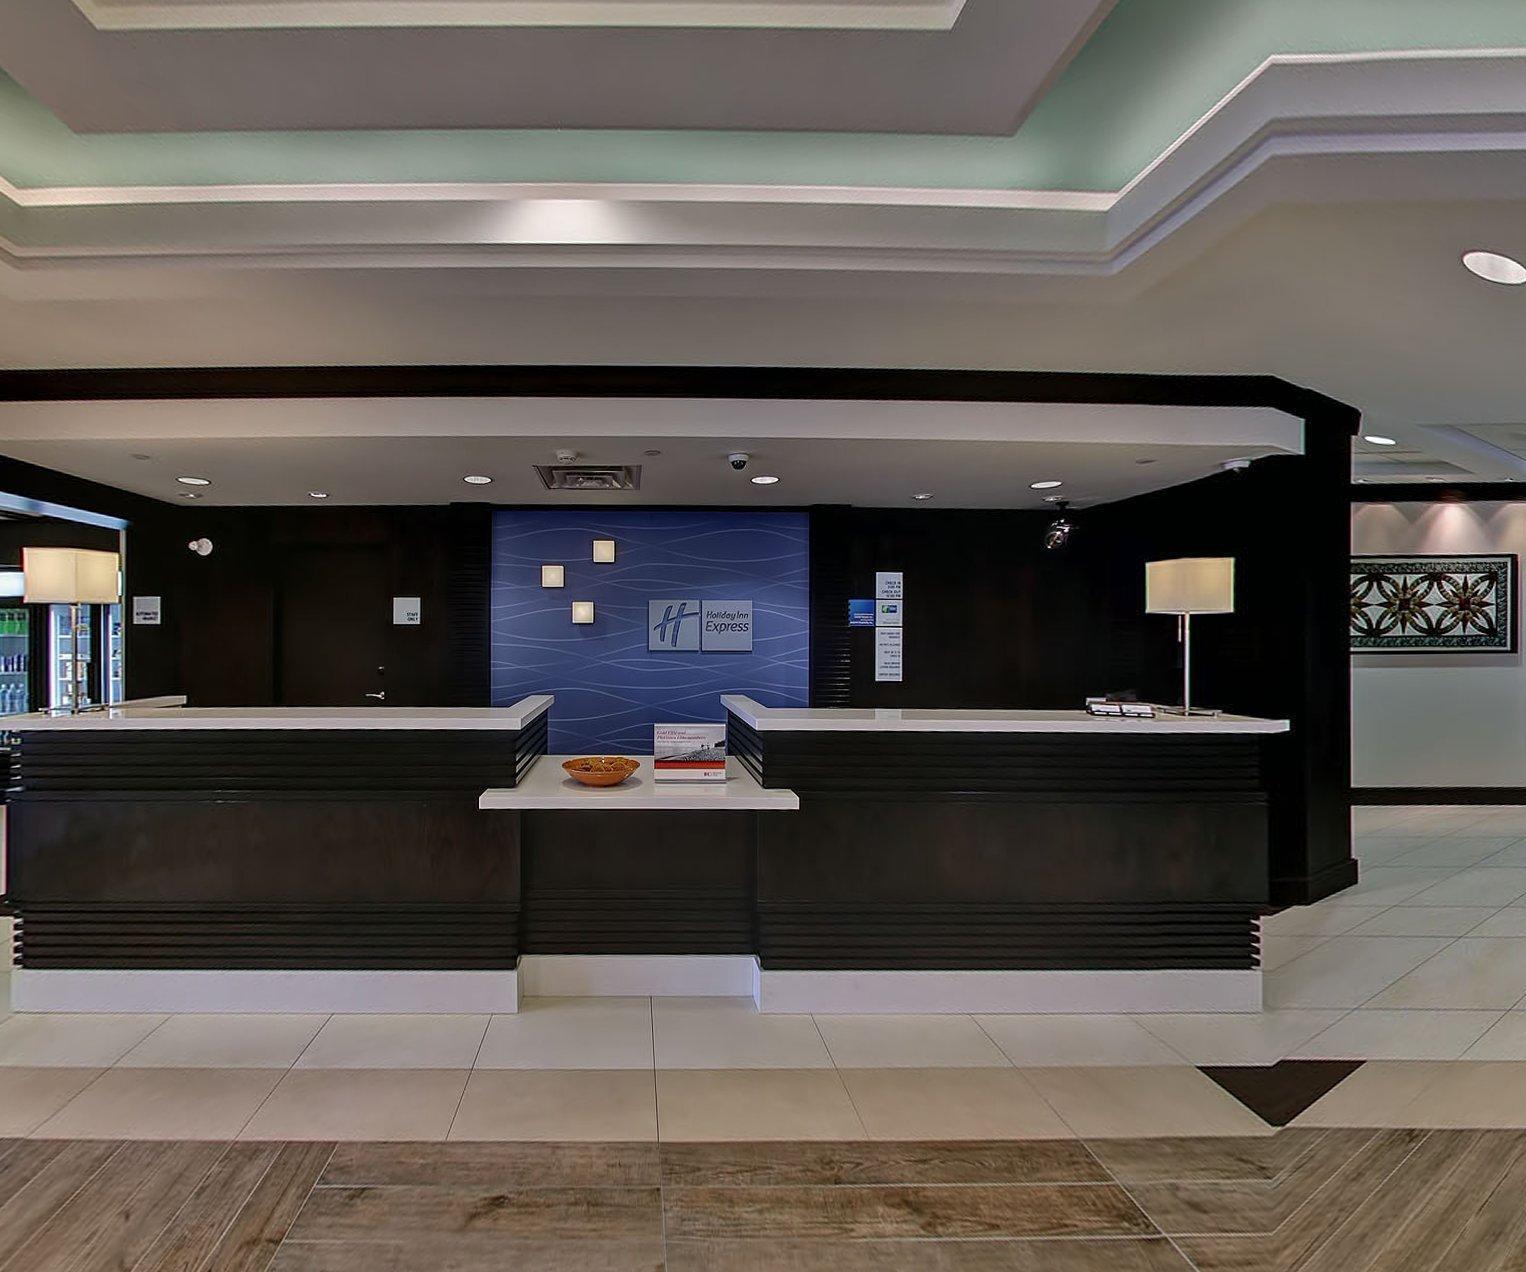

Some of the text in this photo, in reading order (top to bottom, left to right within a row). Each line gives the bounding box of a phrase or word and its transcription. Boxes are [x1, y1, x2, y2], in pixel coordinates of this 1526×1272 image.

[706, 610, 749, 621] Holiday Inn
[705, 621, 750, 634] Express
